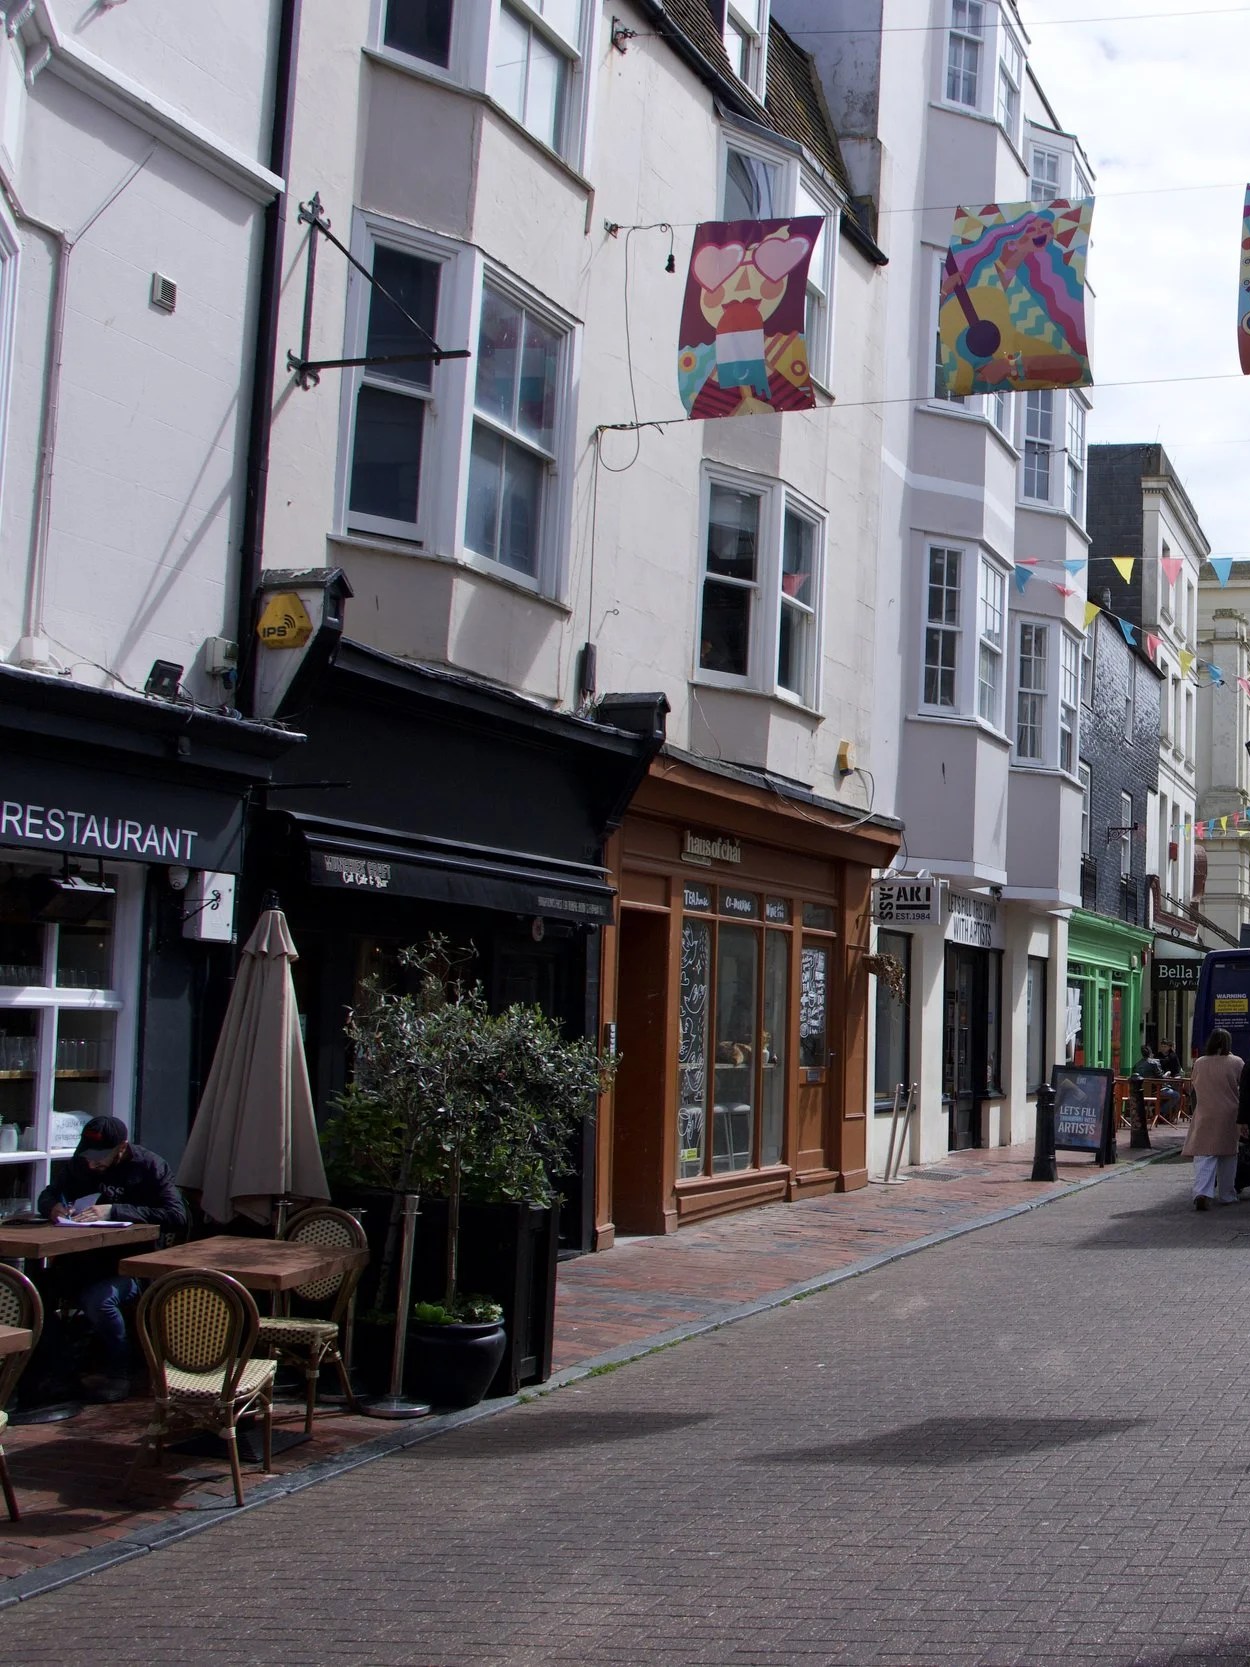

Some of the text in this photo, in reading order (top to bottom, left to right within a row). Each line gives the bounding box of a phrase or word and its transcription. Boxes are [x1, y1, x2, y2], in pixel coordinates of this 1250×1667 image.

[262, 626, 287, 637] IPS
[1, 800, 198, 860] RESTAURANT
[953, 916, 992, 948] WITH ARTISTS
[1158, 964, 1193, 979] Bella
[1060, 1105, 1080, 1116] LET'S
[1081, 1107, 1097, 1118] FILL
[1058, 1121, 1096, 1135] ARTISTS
